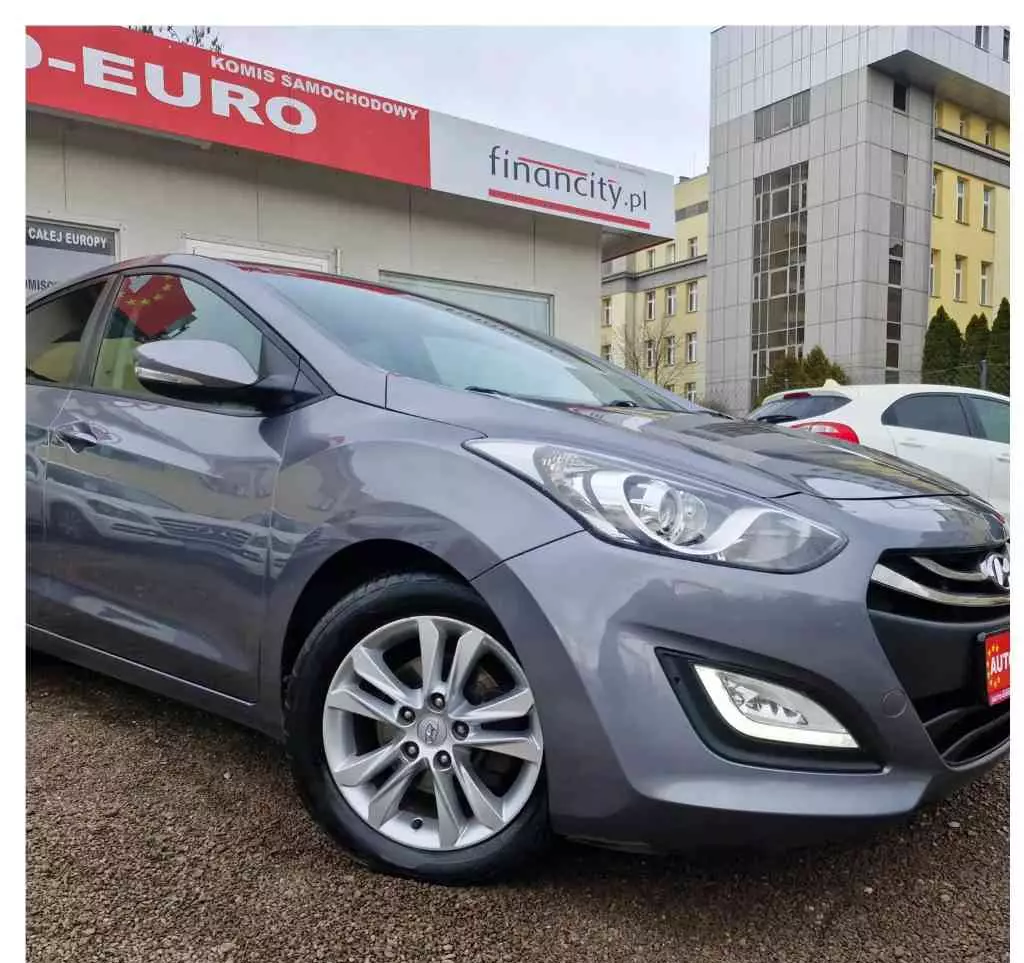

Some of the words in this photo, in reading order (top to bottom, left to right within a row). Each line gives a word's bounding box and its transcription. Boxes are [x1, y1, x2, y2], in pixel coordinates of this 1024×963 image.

[211, 54, 276, 83] KOMIS
[280, 73, 420, 121] SAMOCHODOWY
[488, 145, 648, 213] financity.pl
[65, 231, 107, 249] EUROPY
